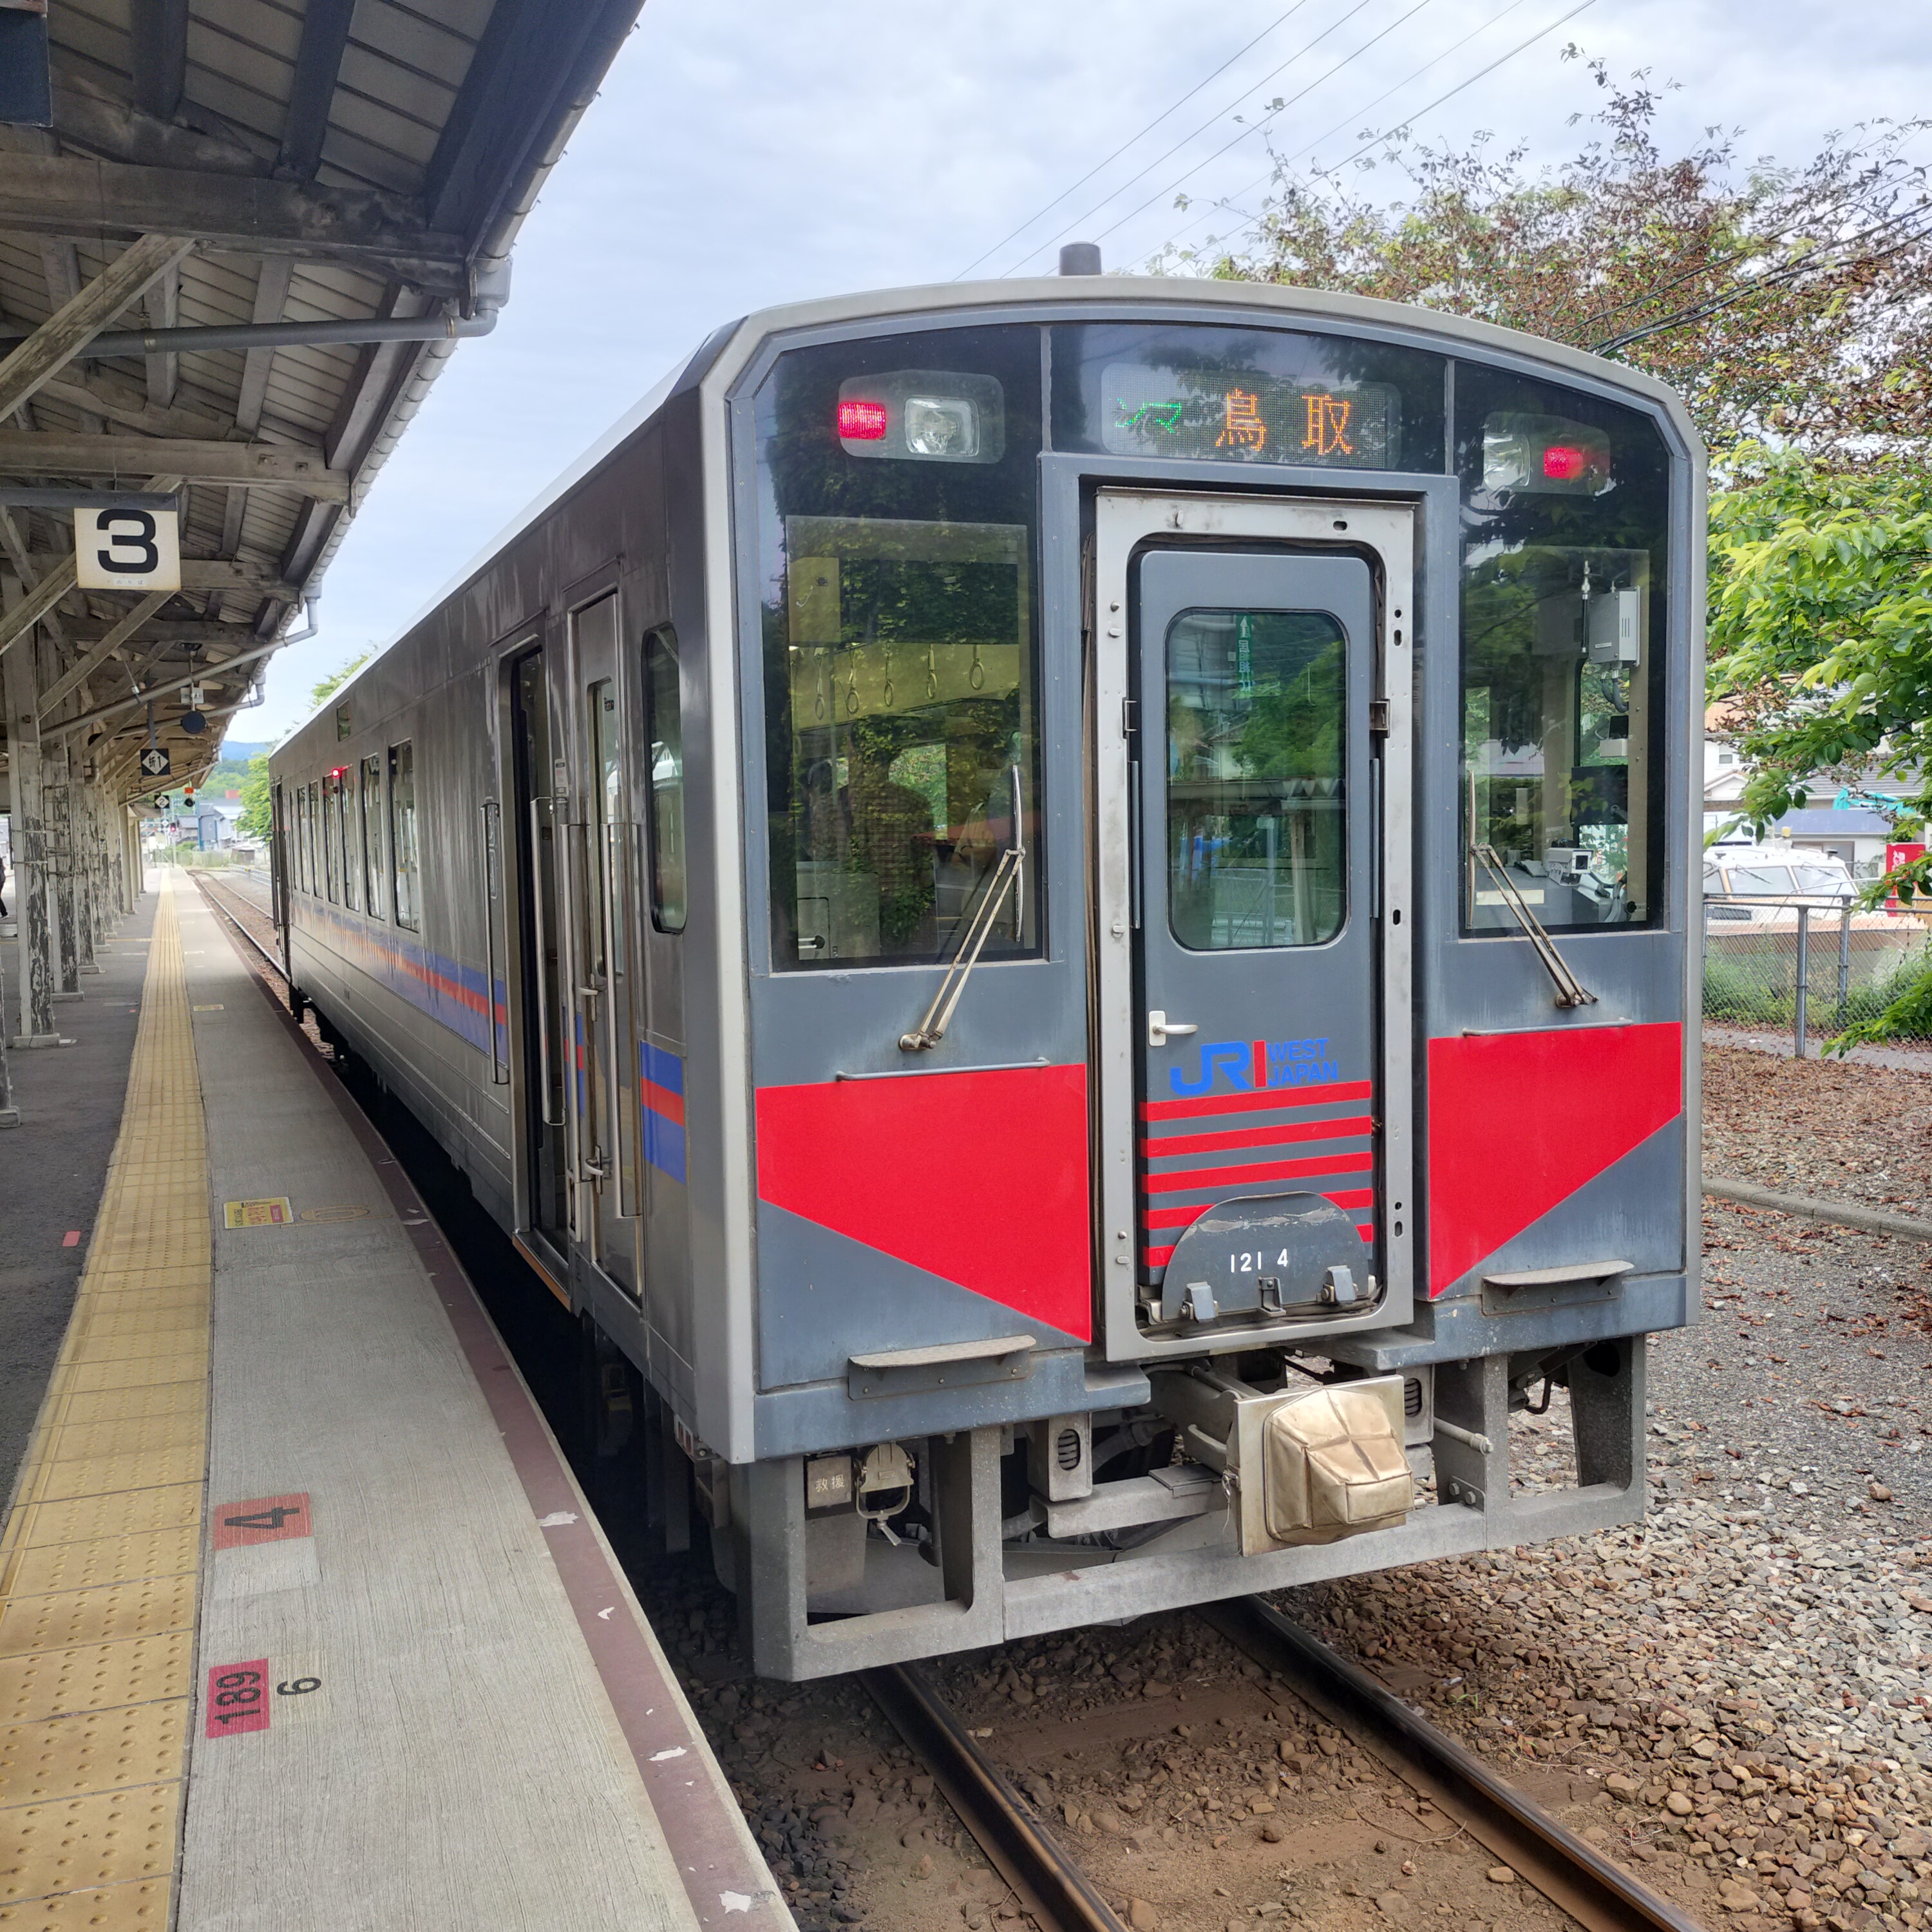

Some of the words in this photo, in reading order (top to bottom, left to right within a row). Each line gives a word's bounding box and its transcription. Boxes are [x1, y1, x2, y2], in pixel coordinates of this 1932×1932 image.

[1215, 386, 1354, 455] 鳥取
[97, 508, 159, 574] 3
[158, 798, 166, 806] 2
[1170, 1040, 1251, 1096] JR
[1267, 1037, 1329, 1063] WEST
[1267, 1059, 1338, 1087] JAPAN
[814, 1473, 846, 1493] 救援
[223, 1506, 301, 1531] 4
[214, 1670, 262, 1725] 189
